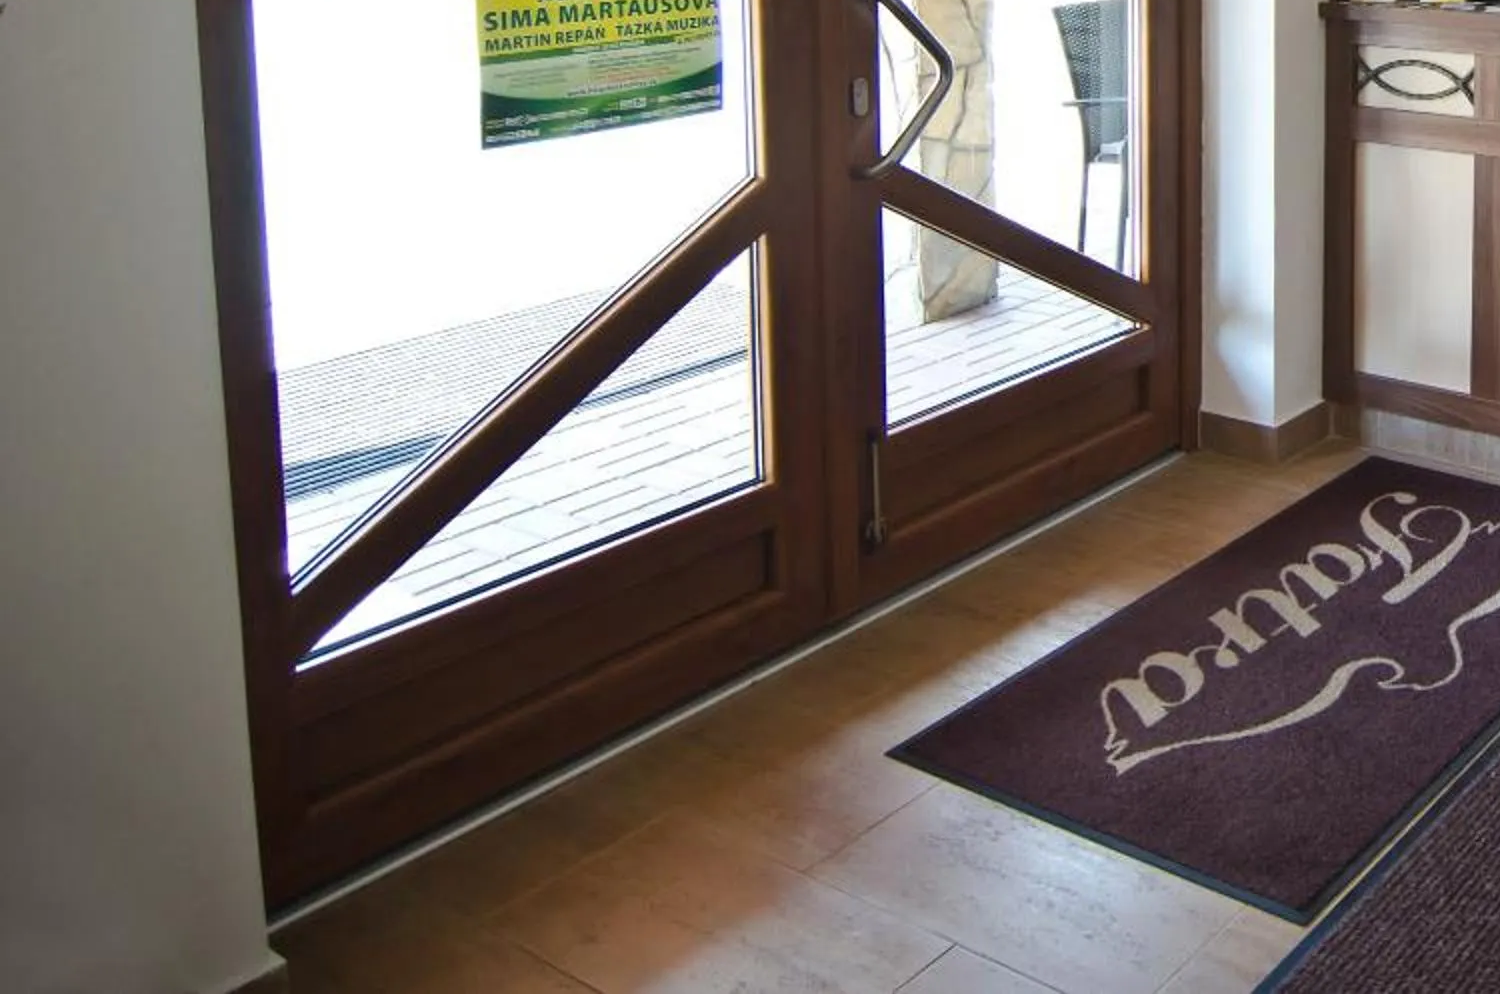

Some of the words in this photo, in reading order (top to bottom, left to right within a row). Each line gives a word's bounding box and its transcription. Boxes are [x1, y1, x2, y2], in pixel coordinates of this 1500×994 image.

[483, 7, 550, 31] SIMA
[484, 33, 551, 53] MARTIN
[1102, 492, 1472, 729] Fatra
